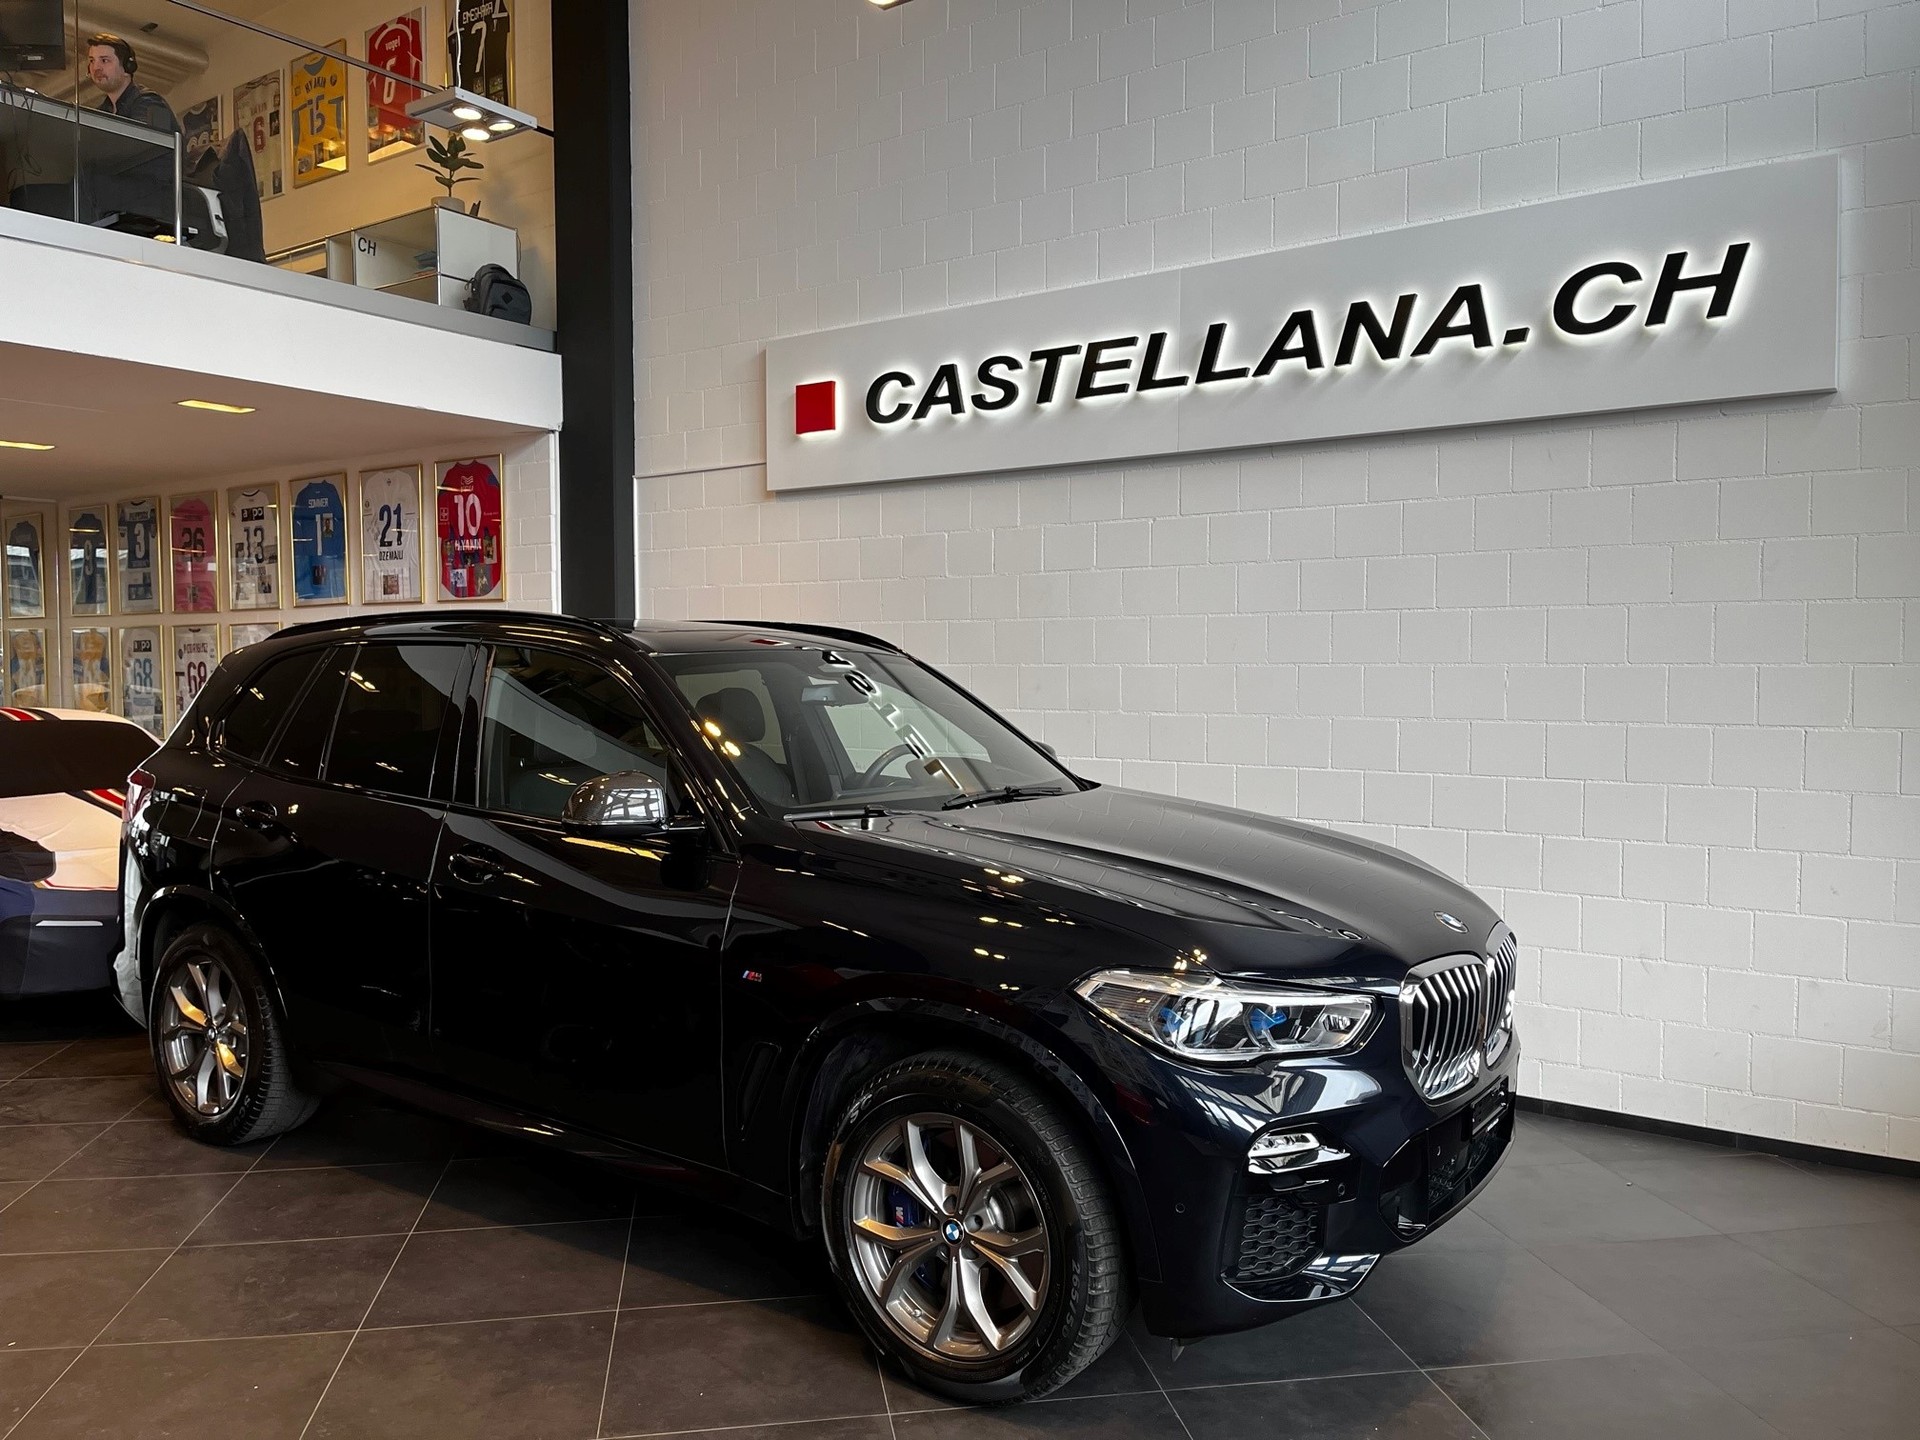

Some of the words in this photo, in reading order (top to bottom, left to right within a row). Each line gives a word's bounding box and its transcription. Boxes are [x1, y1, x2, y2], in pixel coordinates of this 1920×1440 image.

[471, 20, 487, 73] 7
[383, 56, 398, 105] 6
[253, 115, 266, 154] 6
[358, 237, 377, 256] CH
[865, 242, 1750, 425] CASTELLANA.CH
[379, 503, 402, 547] 21
[454, 493, 482, 537] 10
[134, 523, 146, 559] 3
[181, 526, 205, 562] 26
[243, 525, 265, 564] 13
[315, 514, 323, 556] 1
[133, 658, 153, 694] 68
[187, 661, 207, 699] 68
